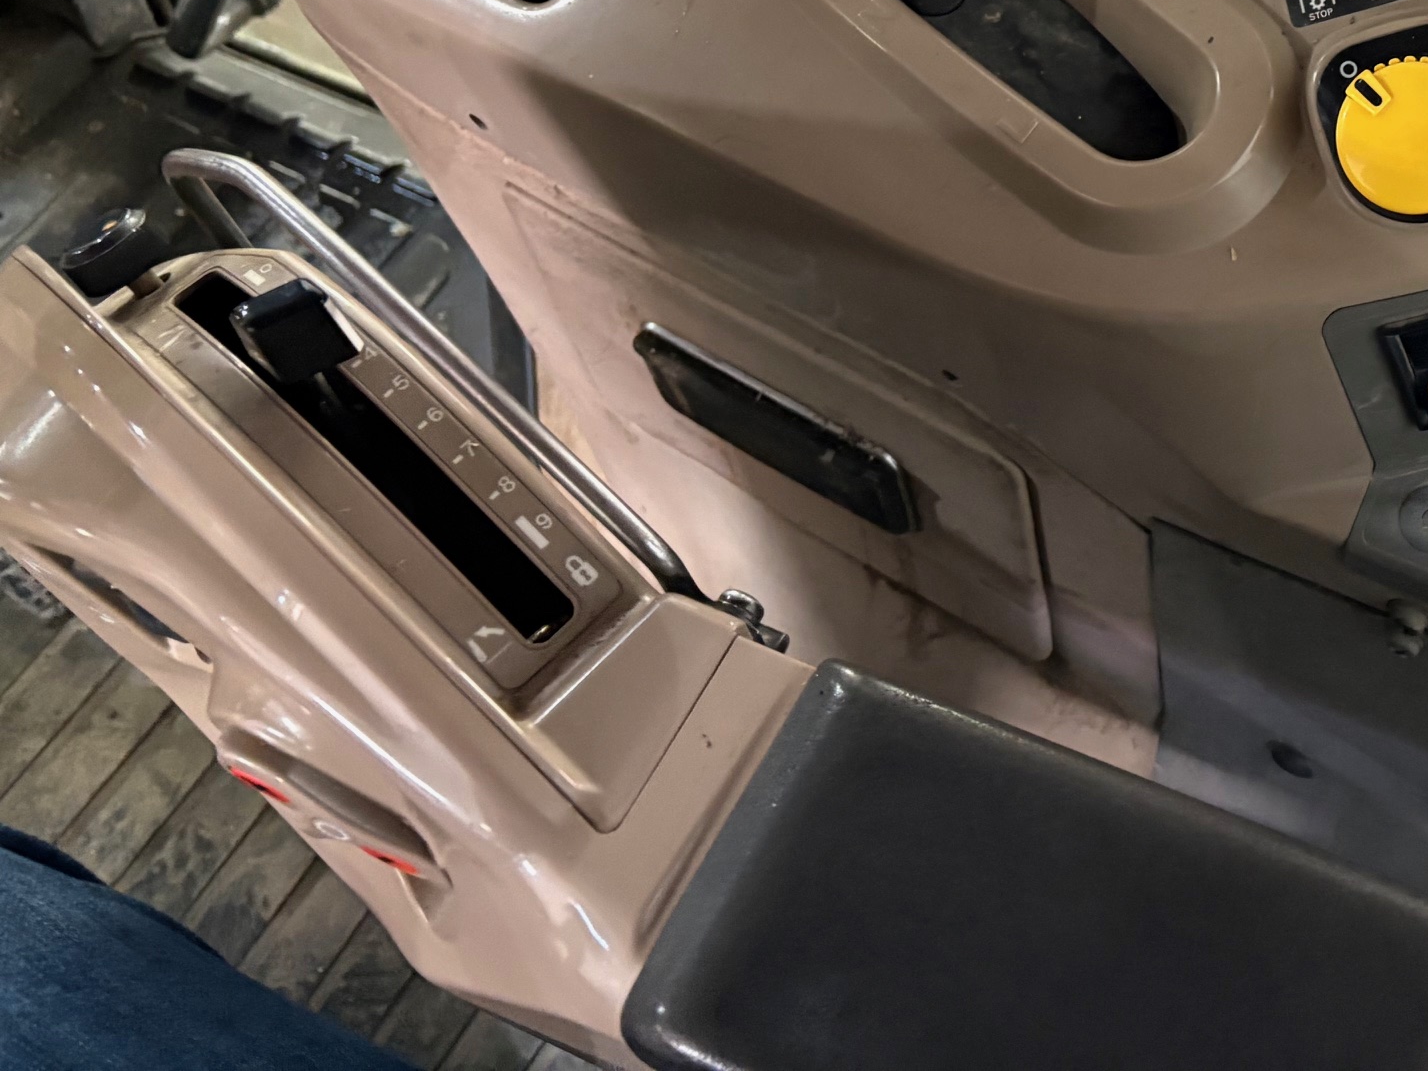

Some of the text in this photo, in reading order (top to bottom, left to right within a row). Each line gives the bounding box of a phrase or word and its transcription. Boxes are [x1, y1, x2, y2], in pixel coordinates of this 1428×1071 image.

[1309, 7, 1333, 21] STOP
[391, 374, 410, 391] 5
[427, 407, 444, 422] 6
[498, 475, 516, 492] 8
[535, 513, 553, 529] 9
